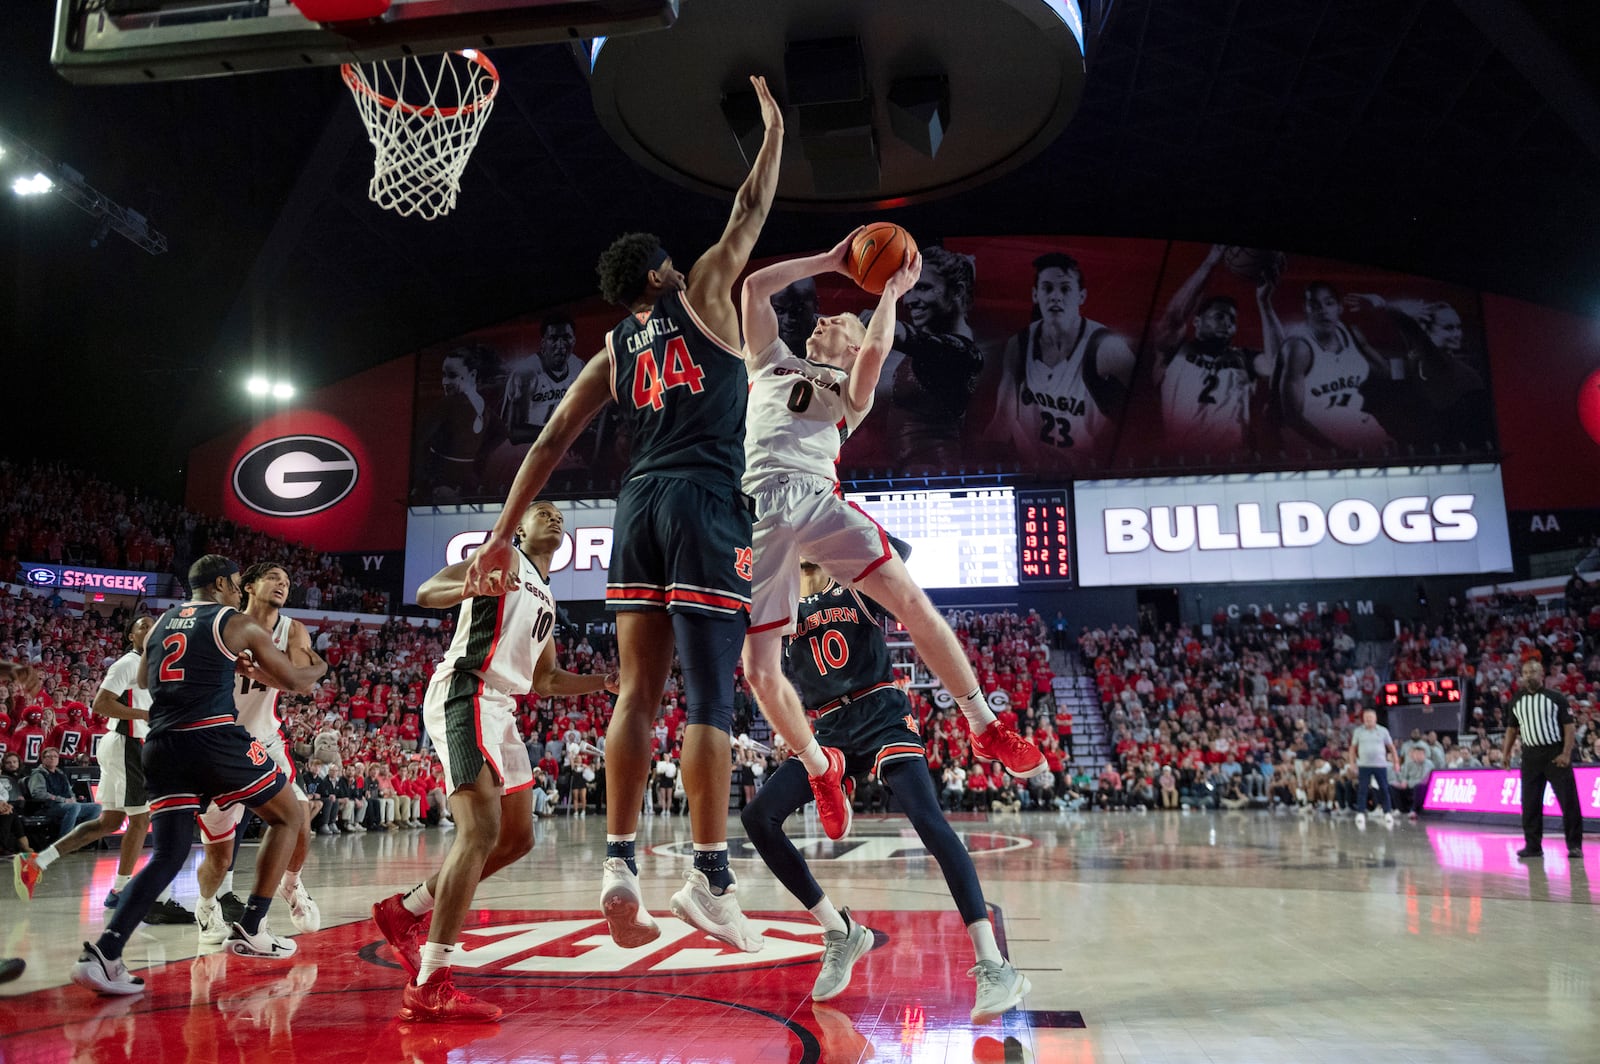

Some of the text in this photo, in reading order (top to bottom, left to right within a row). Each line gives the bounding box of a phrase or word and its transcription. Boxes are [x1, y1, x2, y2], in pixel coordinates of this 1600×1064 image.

[632, 335, 706, 412] 44
[787, 380, 814, 413] 0
[1198, 374, 1220, 404] 2
[1040, 411, 1074, 448] 23
[1028, 506, 1065, 519] 2 1 4
[1104, 494, 1479, 554] BULLDOGS
[1530, 515, 1560, 532] AA
[1025, 520, 1066, 533] 10 1 3
[1026, 534, 1066, 547] 13 1 9
[362, 555, 384, 570] YY
[1023, 548, 1067, 562] 31 2 2
[62, 570, 148, 592] SEATGEEK
[1023, 562, 1068, 576] 44 1 2
[165, 617, 197, 630] JONES
[531, 606, 553, 643] 10
[159, 632, 188, 682] 2
[809, 629, 849, 677] 10
[60, 730, 81, 756] R
